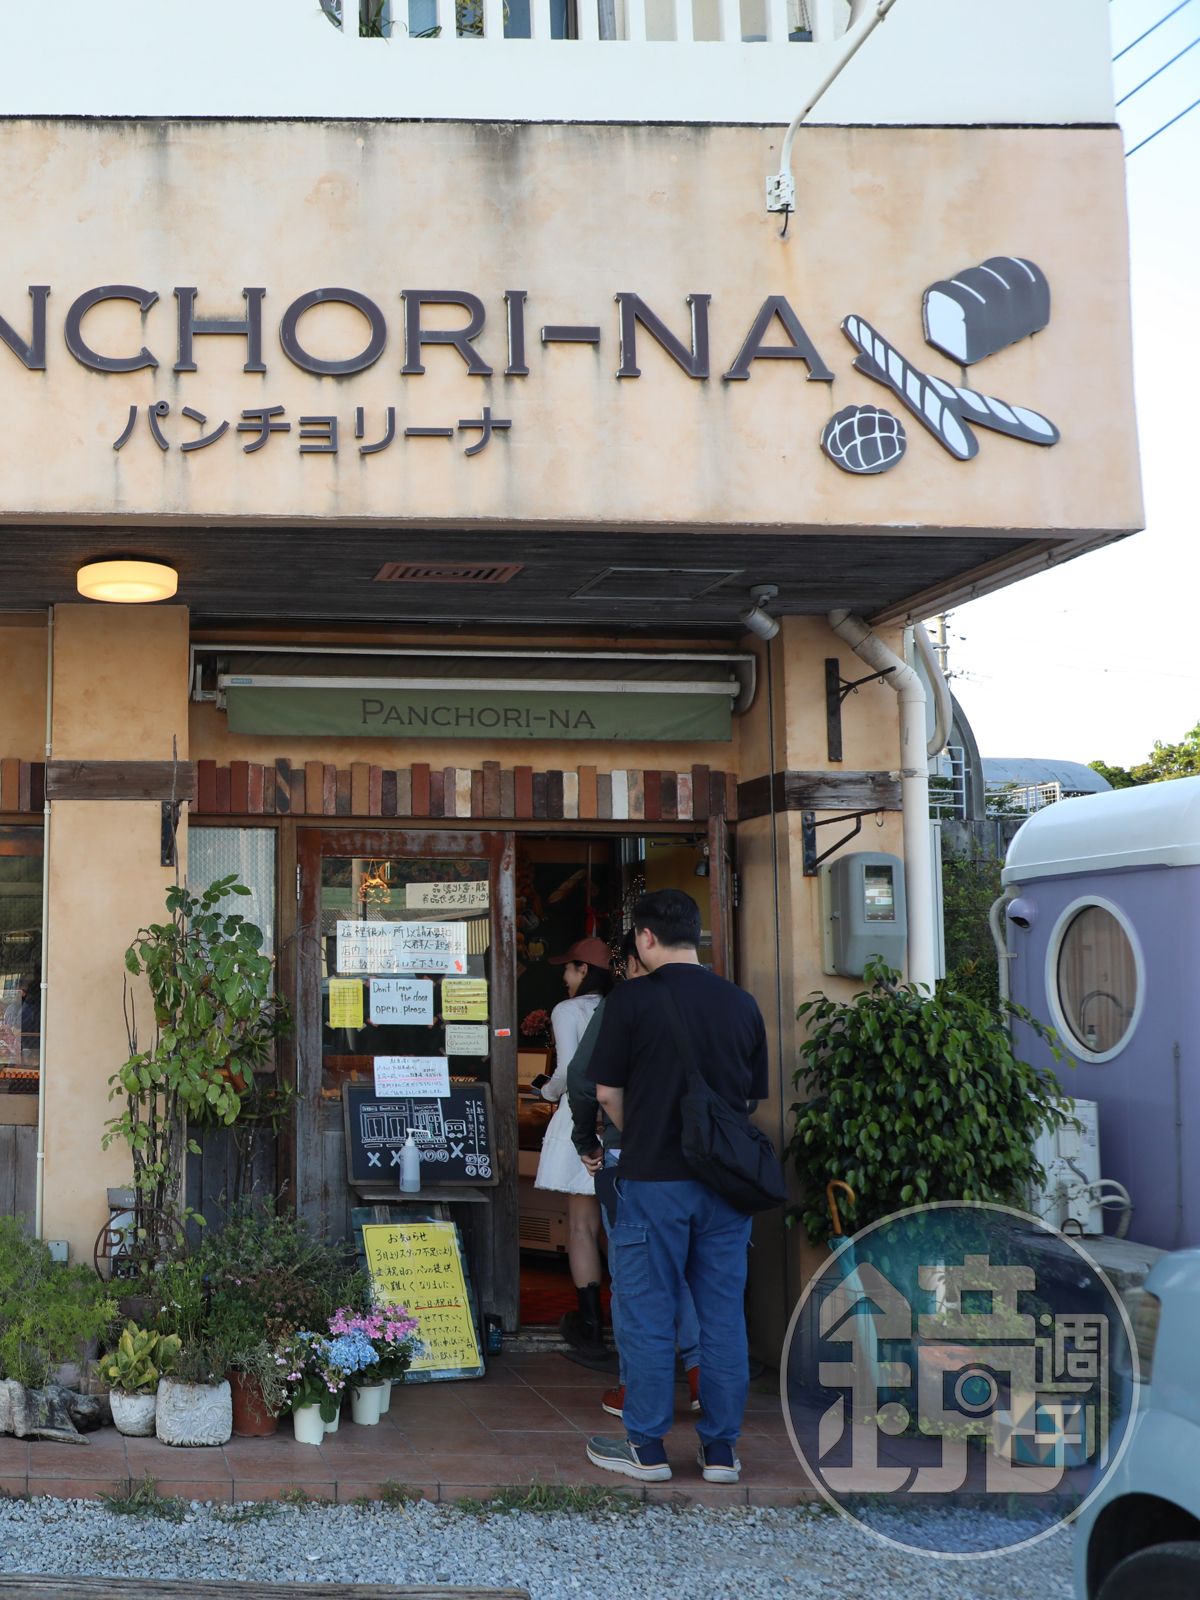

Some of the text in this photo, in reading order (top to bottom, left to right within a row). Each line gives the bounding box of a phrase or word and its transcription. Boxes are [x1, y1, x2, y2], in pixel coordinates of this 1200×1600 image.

[112, 402, 512, 456] パンチョリーナ
[361, 699, 596, 730] PANCHORI-NA
[375, 1005, 427, 1016] open please
[387, 1232, 428, 1244] お知らせ
